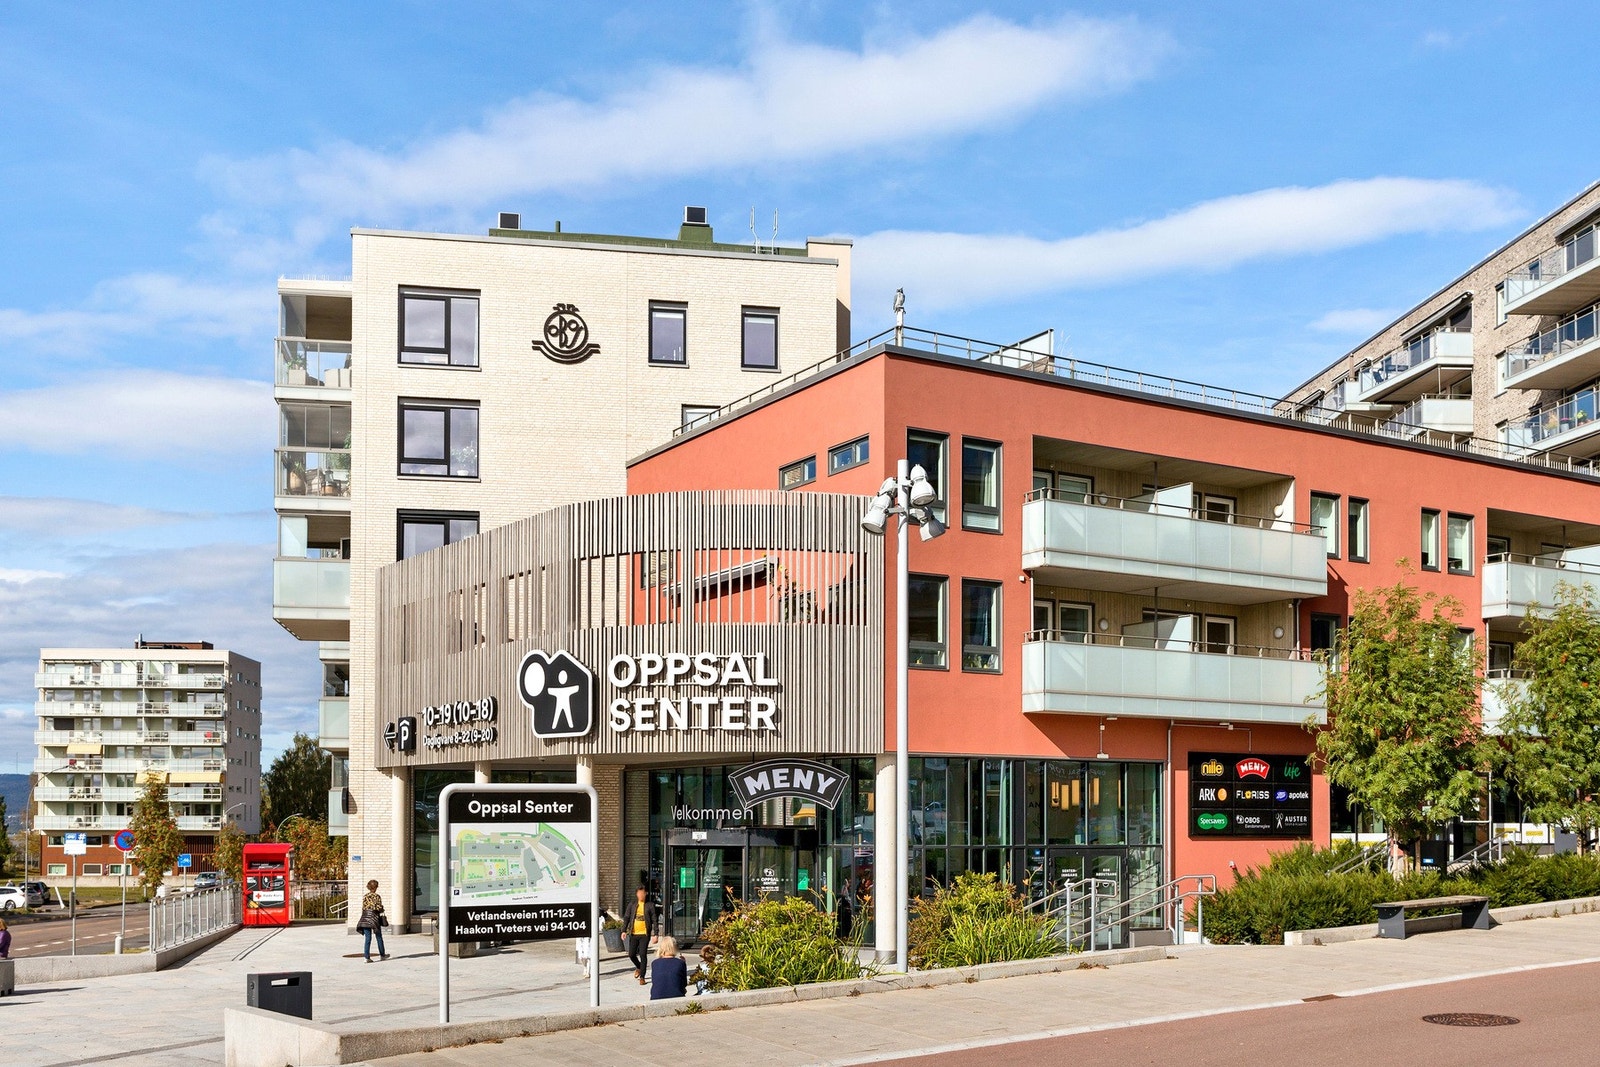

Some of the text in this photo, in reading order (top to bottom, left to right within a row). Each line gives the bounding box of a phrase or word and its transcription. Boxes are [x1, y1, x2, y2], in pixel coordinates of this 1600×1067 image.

[608, 652, 779, 689] OPPSAL
[609, 696, 778, 733] SENTER
[423, 733, 454, 749] Dagligvare
[1202, 760, 1223, 776] nille
[1240, 761, 1266, 773] MENY
[743, 768, 837, 796] MENY
[1199, 788, 1216, 801] ARK
[1236, 790, 1270, 800] FLORISS
[1288, 790, 1309, 801] apotek
[467, 800, 573, 818] Oppsal Senter
[670, 805, 754, 821] Velkommen
[1200, 817, 1226, 825] Specsavers
[1244, 816, 1260, 824] OBOS
[467, 908, 575, 921] Vetlandsveien 111-123
[455, 921, 587, 935] Haakon Tveters vei 94-104
